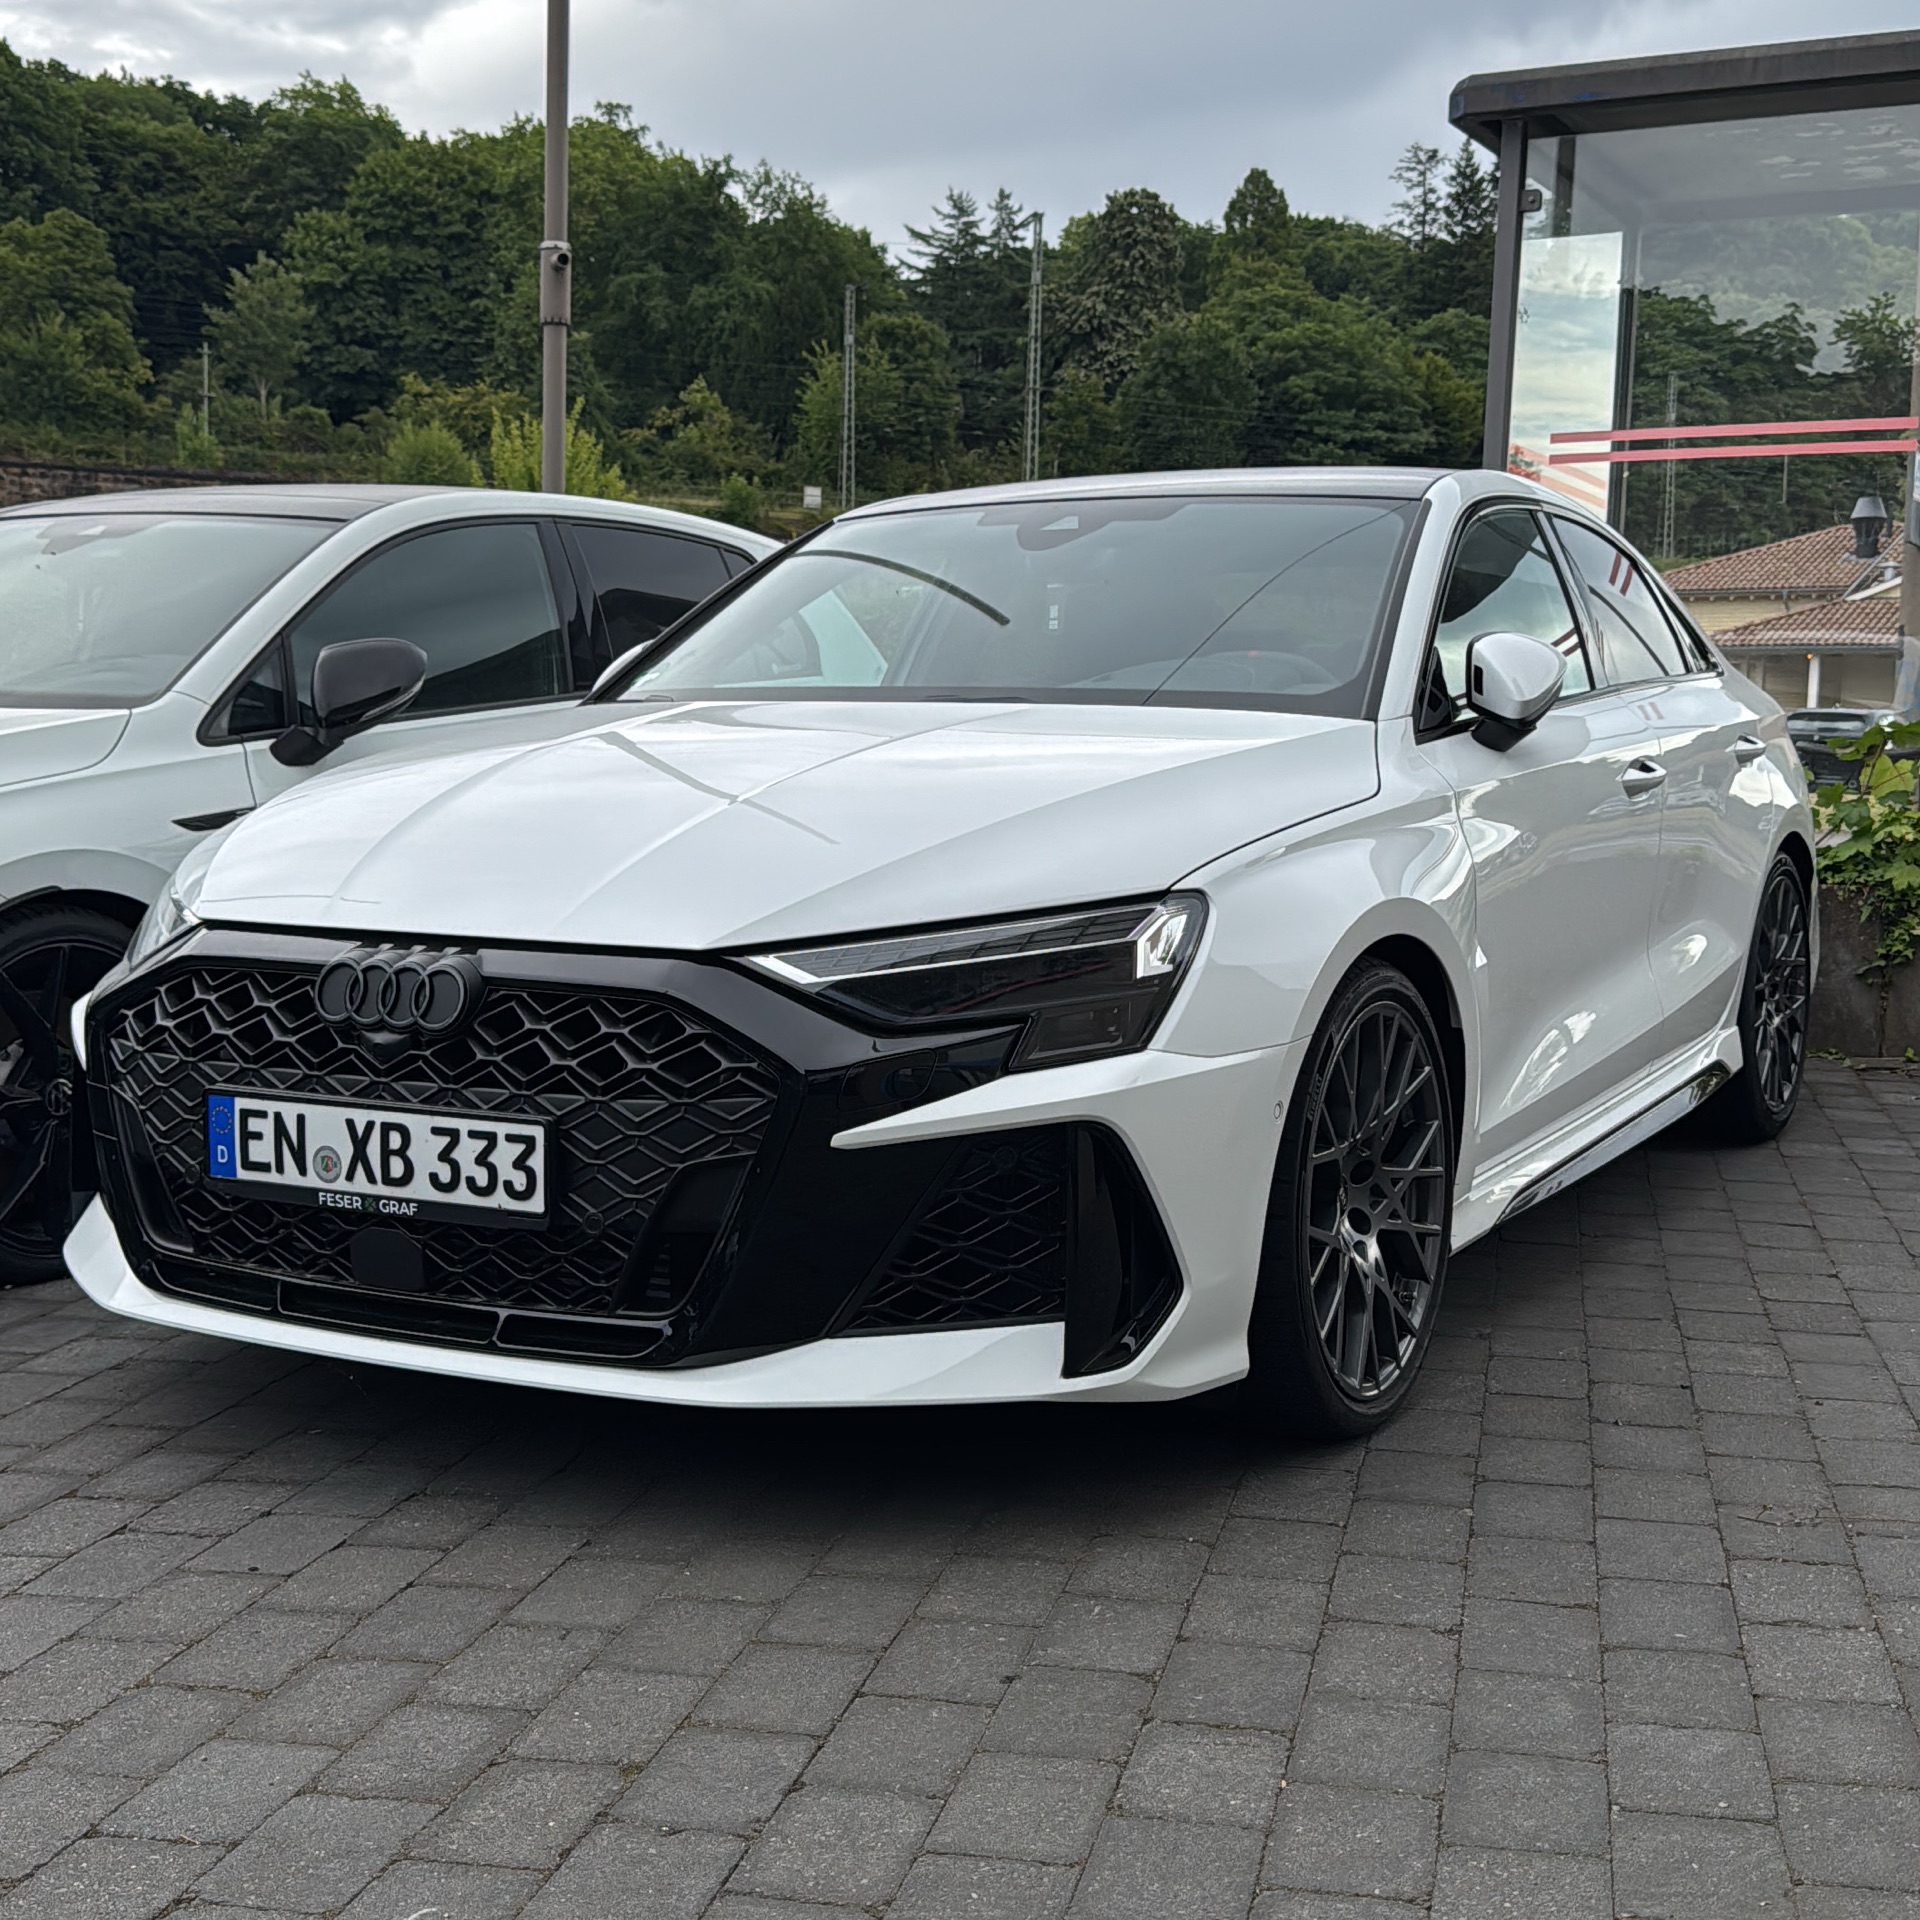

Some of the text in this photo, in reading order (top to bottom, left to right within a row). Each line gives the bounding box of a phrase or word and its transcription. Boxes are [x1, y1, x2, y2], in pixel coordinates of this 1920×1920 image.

[217, 1145, 228, 1163] D
[239, 1108, 307, 1176] EN
[345, 1118, 414, 1187] XB
[429, 1127, 537, 1201] 333
[318, 1191, 418, 1216] FESER GRAF
